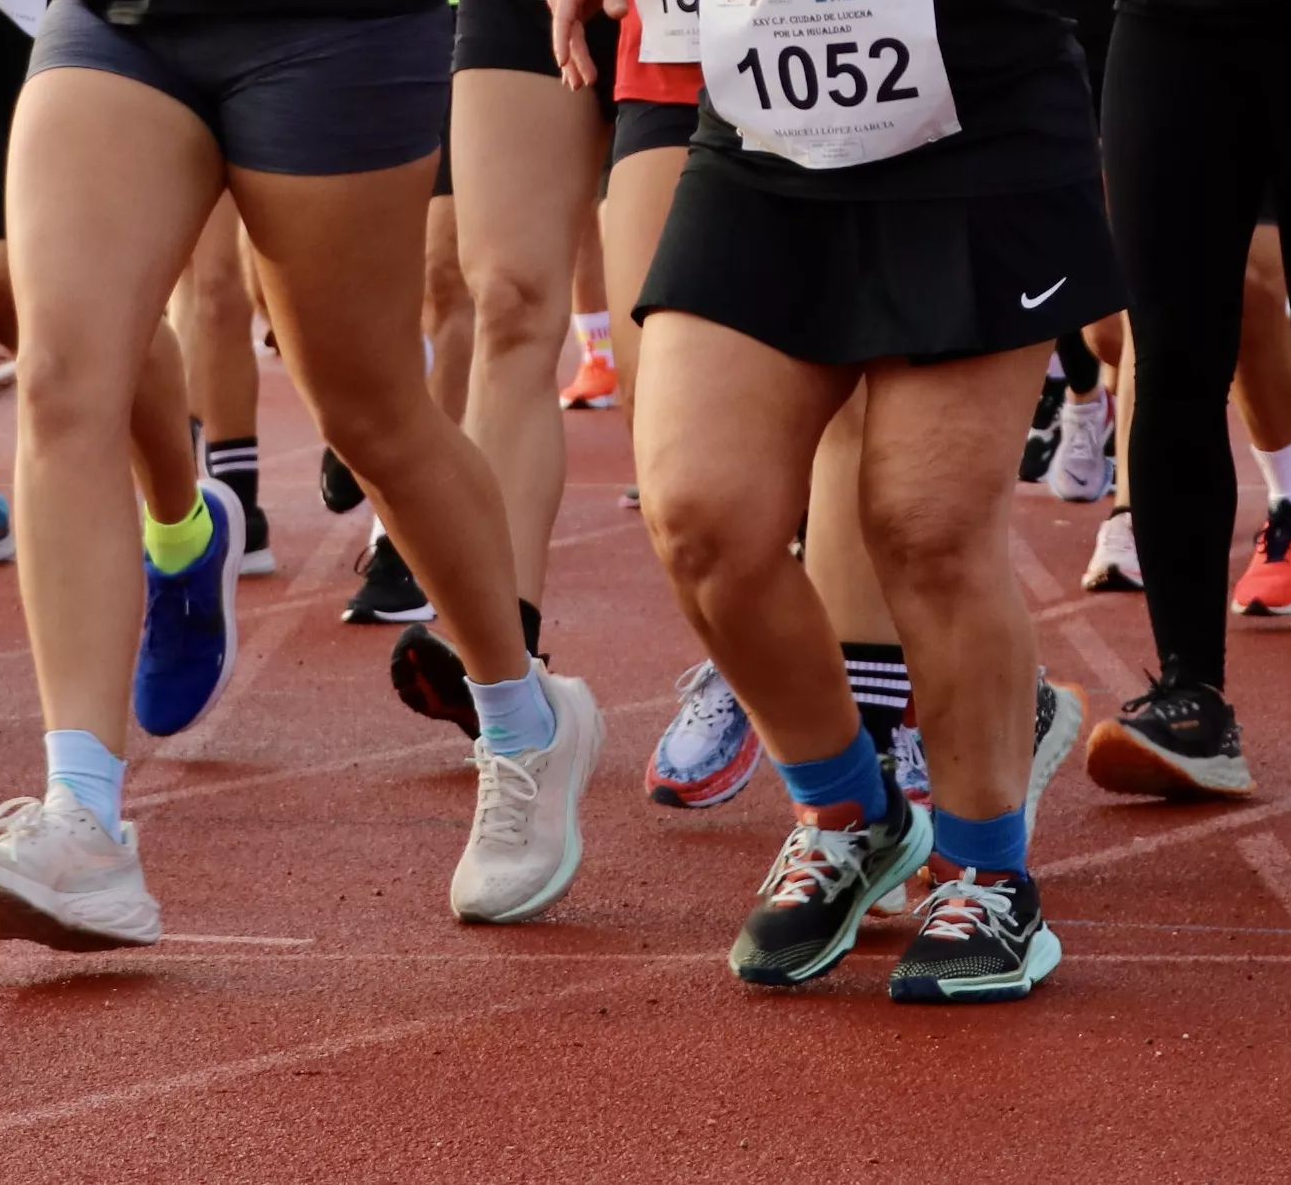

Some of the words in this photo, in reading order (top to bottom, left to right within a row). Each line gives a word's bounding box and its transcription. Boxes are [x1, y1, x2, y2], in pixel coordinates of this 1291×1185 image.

[789, 14, 822, 25] CIUDAD
[823, 12, 835, 23] DE
[837, 9, 874, 20] LUCENA
[774, 30, 791, 39] POR
[792, 28, 805, 38] LA
[806, 25, 853, 37] IGUALDAD
[737, 37, 920, 111] 1052
